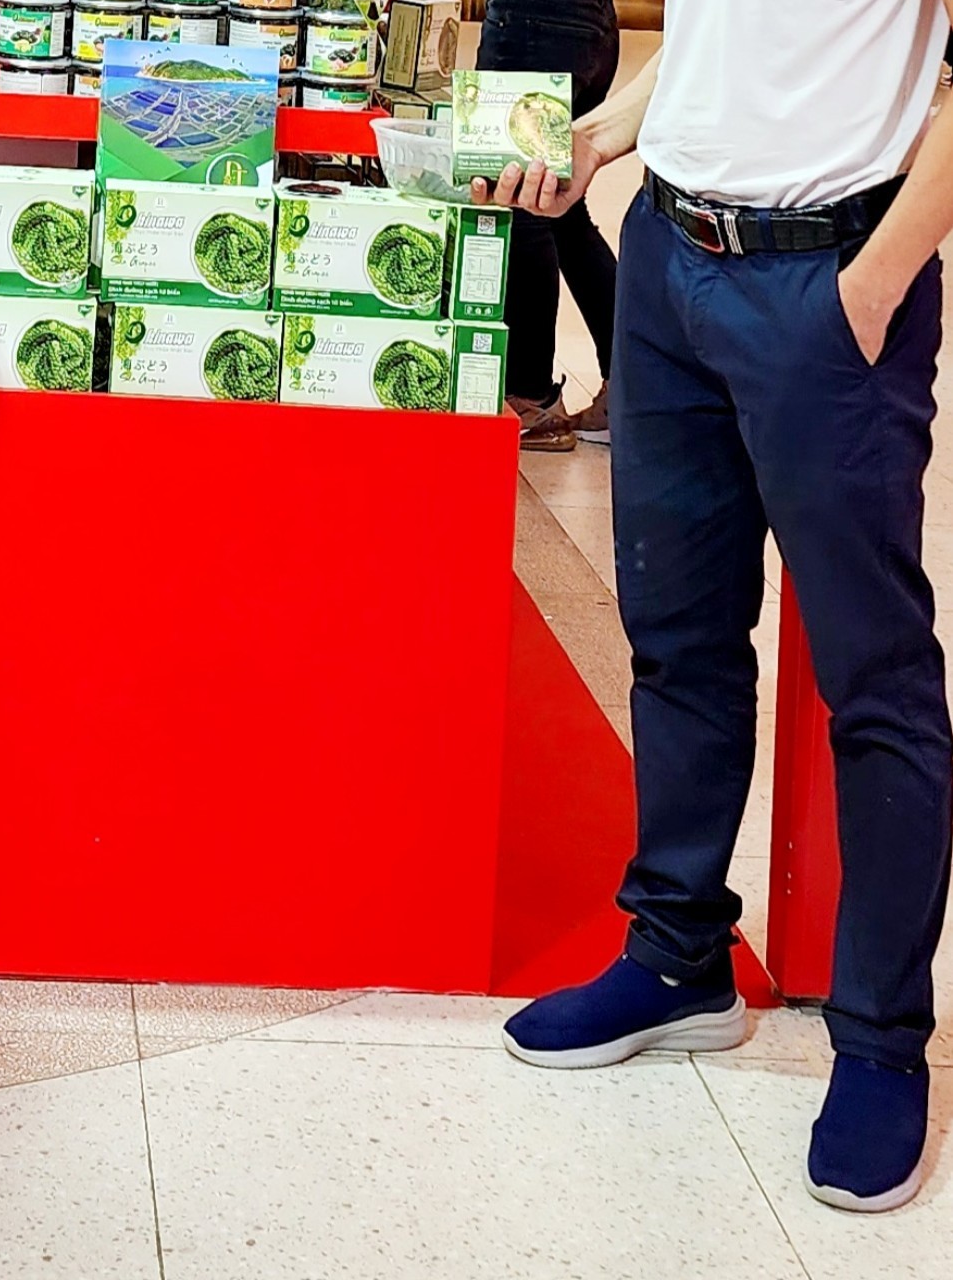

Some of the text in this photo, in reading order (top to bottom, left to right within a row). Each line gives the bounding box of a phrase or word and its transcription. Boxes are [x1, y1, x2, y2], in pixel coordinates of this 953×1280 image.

[116, 204, 185, 229] Okinawa
[289, 214, 358, 240] Okinawa
[126, 321, 195, 346] Okinawa
[295, 330, 364, 355] Okinawa
